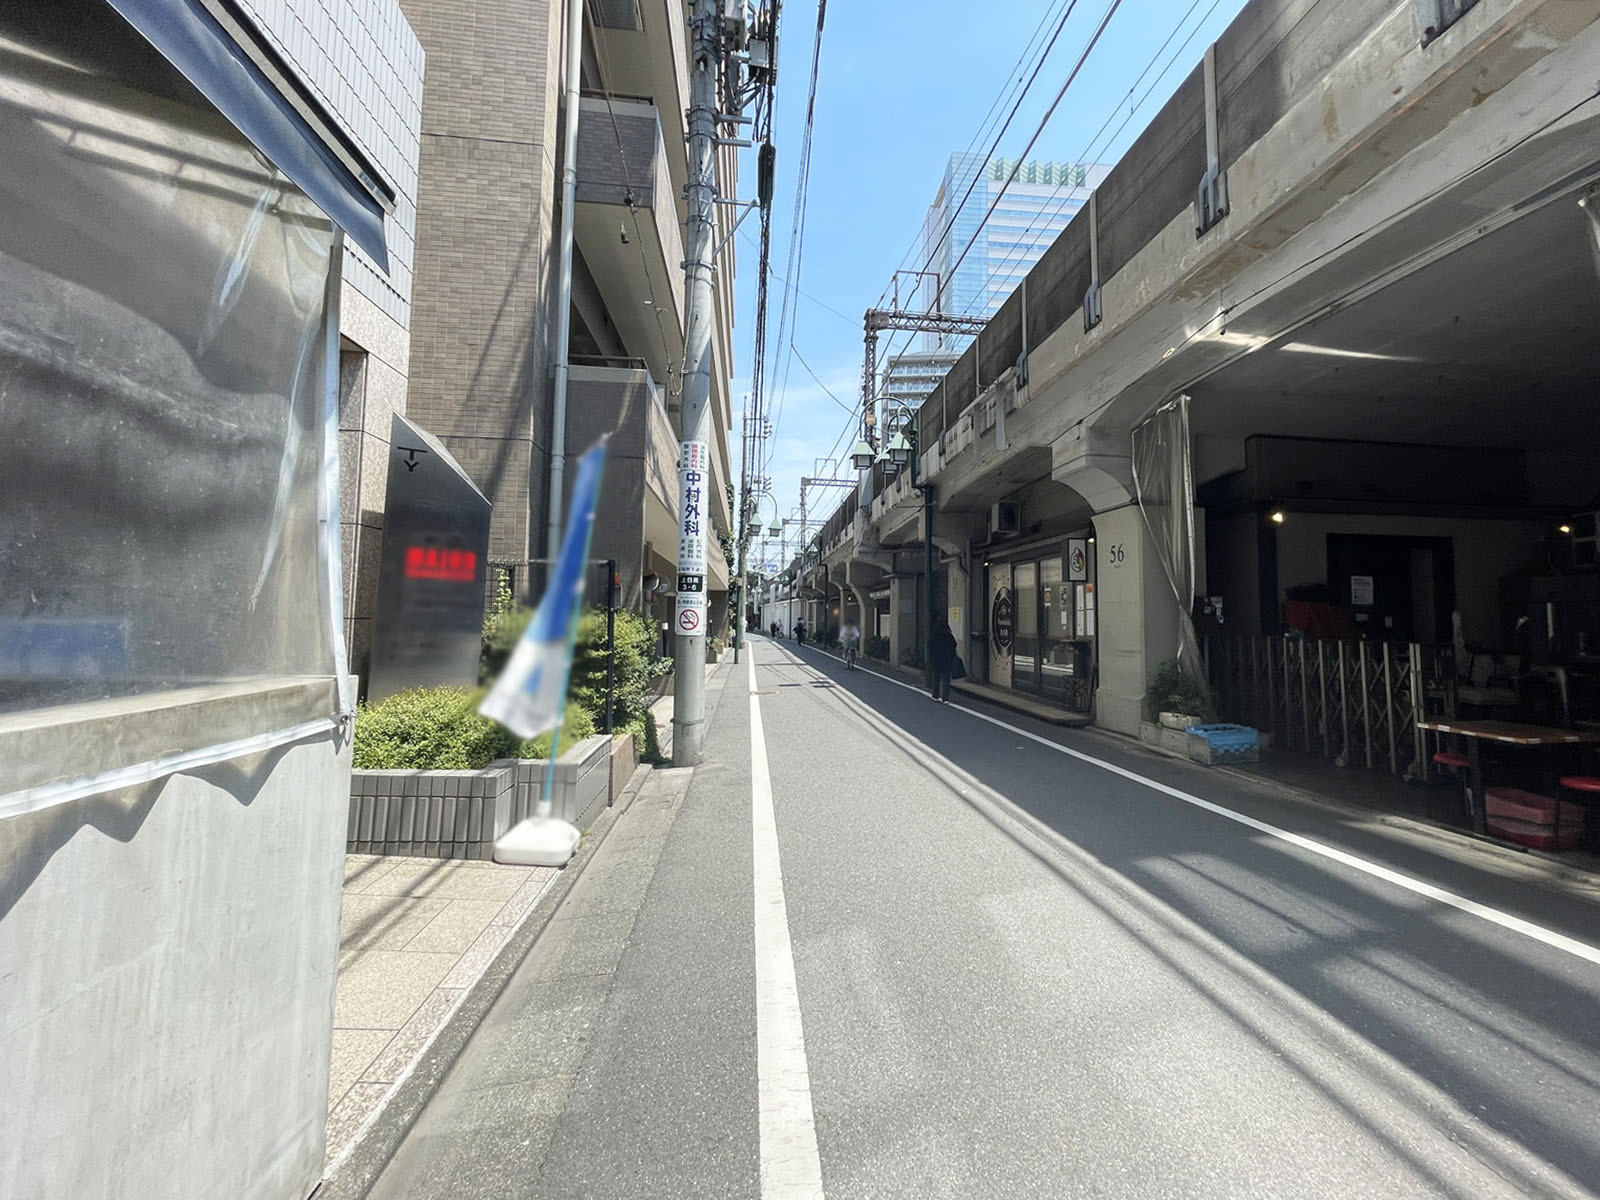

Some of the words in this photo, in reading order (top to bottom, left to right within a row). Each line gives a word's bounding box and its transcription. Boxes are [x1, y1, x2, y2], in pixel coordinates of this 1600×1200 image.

[685, 470, 701, 537] 中村外科
[1110, 543, 1124, 563] 56
